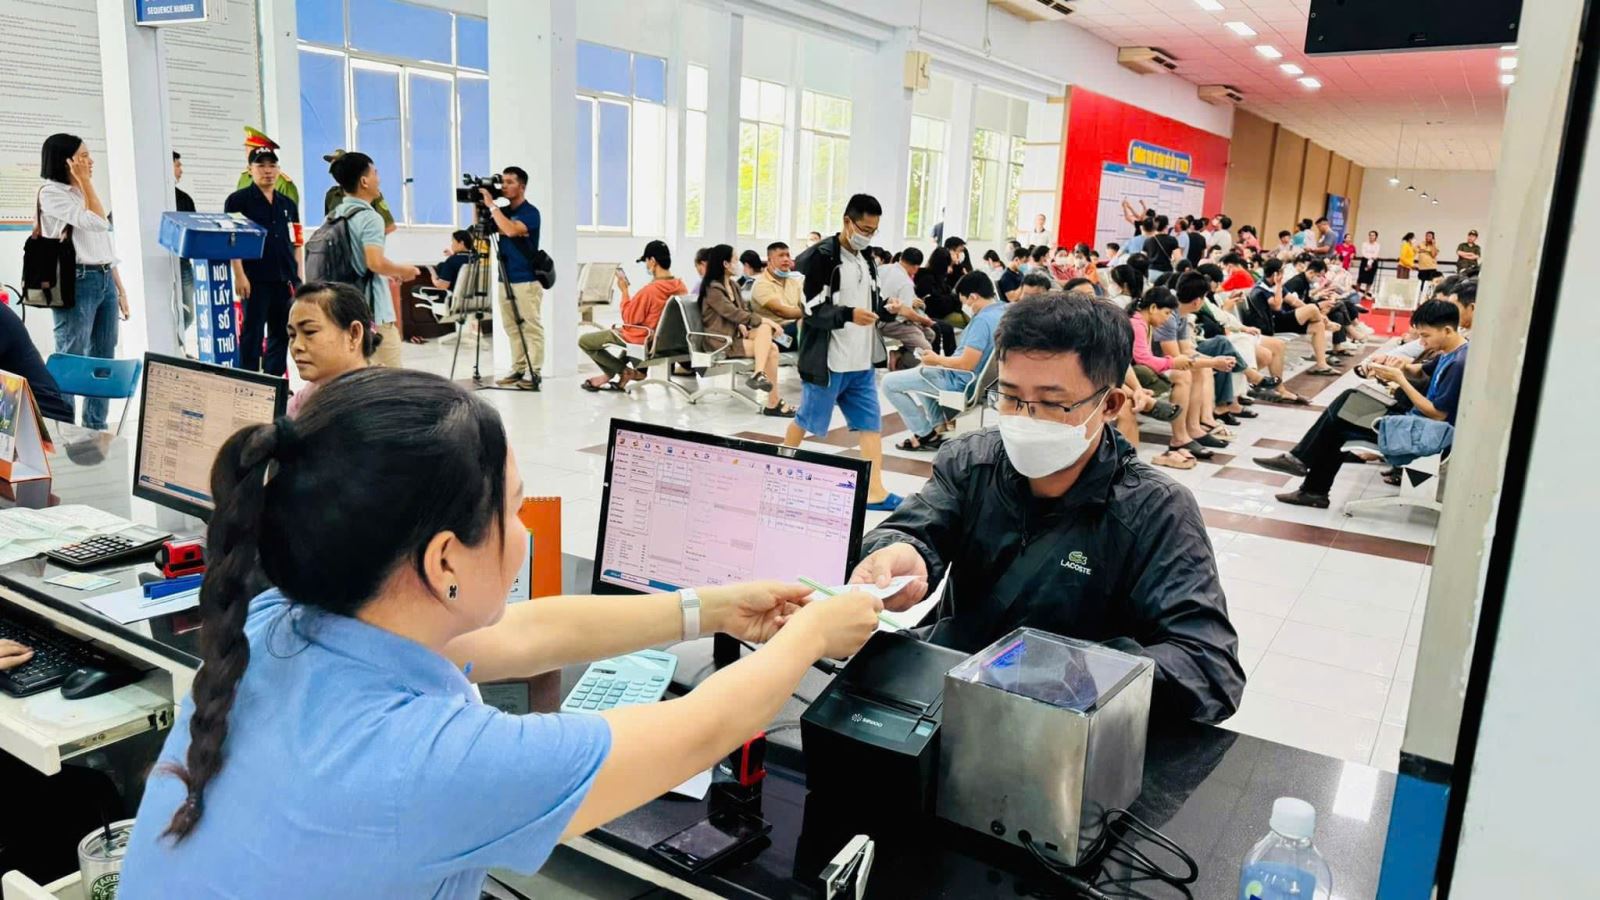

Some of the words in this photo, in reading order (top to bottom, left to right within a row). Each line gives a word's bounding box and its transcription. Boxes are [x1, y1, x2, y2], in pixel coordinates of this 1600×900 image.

[212, 264, 228, 281] NƠI
[213, 283, 230, 305] LẤY
[218, 308, 230, 330] SỐ
[217, 333, 235, 353] THỨ
[1060, 559, 1091, 575] LACOSTE
[93, 874, 119, 893] STARB
